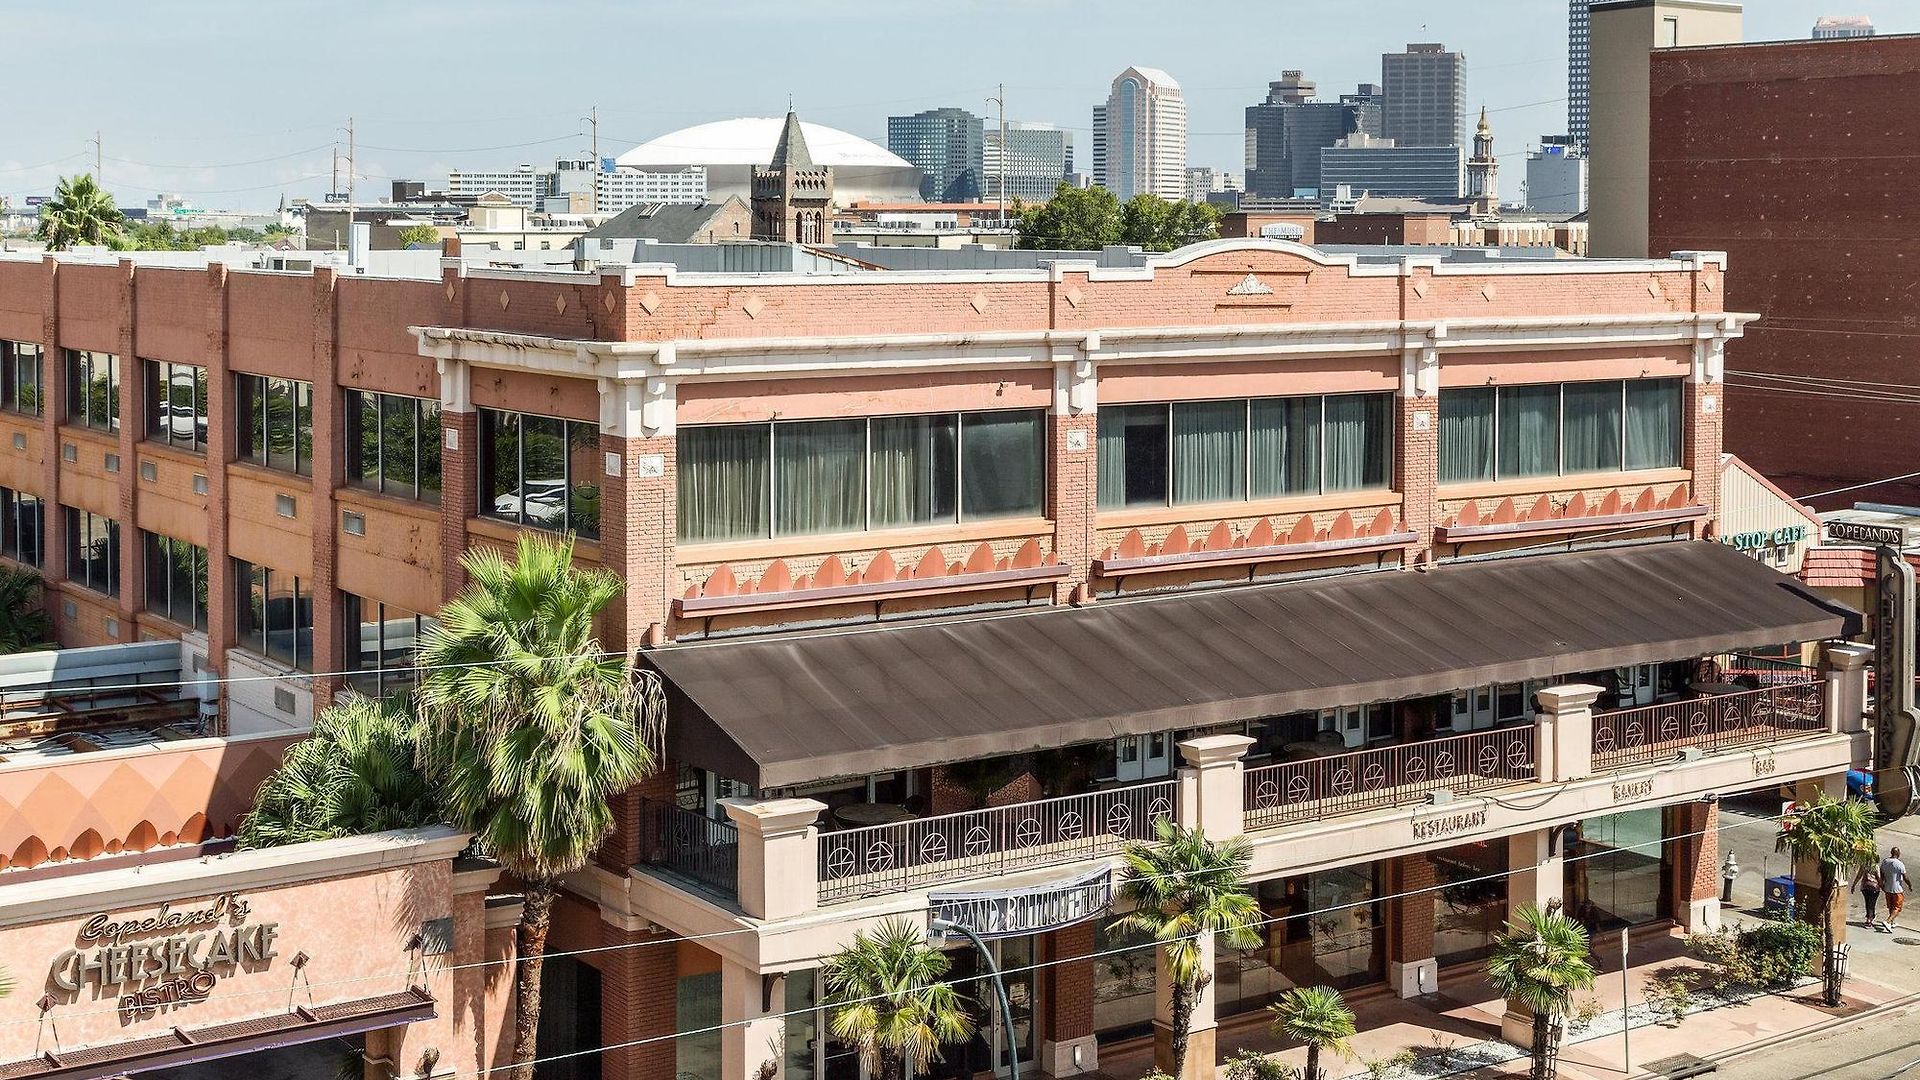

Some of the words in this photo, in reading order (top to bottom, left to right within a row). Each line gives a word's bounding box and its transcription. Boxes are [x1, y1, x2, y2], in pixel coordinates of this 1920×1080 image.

[1733, 531, 1767, 551] STOP
[1773, 526, 1807, 545] CAFE
[1828, 523, 1900, 543] COPELAND'S
[1412, 810, 1487, 840] RESTAURANT
[79, 893, 252, 945] Copeland's
[939, 897, 1000, 933] GRAND
[53, 922, 279, 991] CHEESECAKE
[123, 970, 217, 1018] BISTRO
